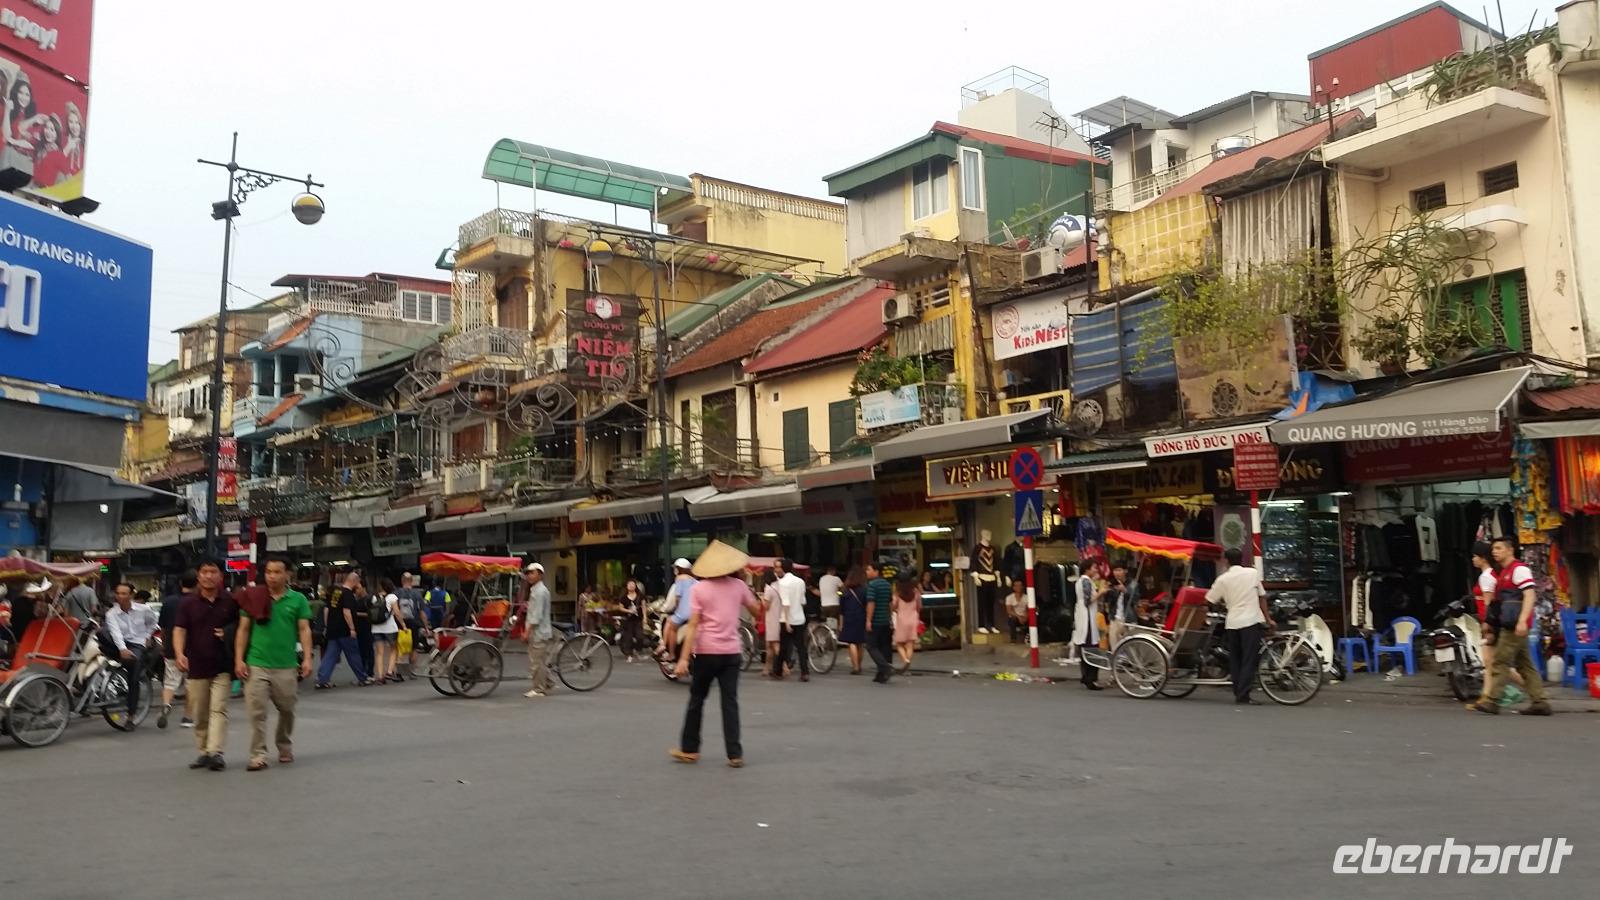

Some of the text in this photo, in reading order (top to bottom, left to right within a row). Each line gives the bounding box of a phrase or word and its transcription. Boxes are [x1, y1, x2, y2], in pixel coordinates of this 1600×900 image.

[1, 7, 58, 51] ngay!
[23, 234, 74, 264] TRANG
[75, 250, 95, 272] HÀ
[97, 258, 122, 281] NỘI
[1035, 326, 1069, 345] NEST
[1153, 439, 1183, 454] ĐỒNG
[1185, 434, 1201, 451] HỒ
[1202, 432, 1228, 449] ĐỨC
[1287, 420, 1417, 443] QUANG HƯƠNG
[943, 457, 983, 489] VIỆT
